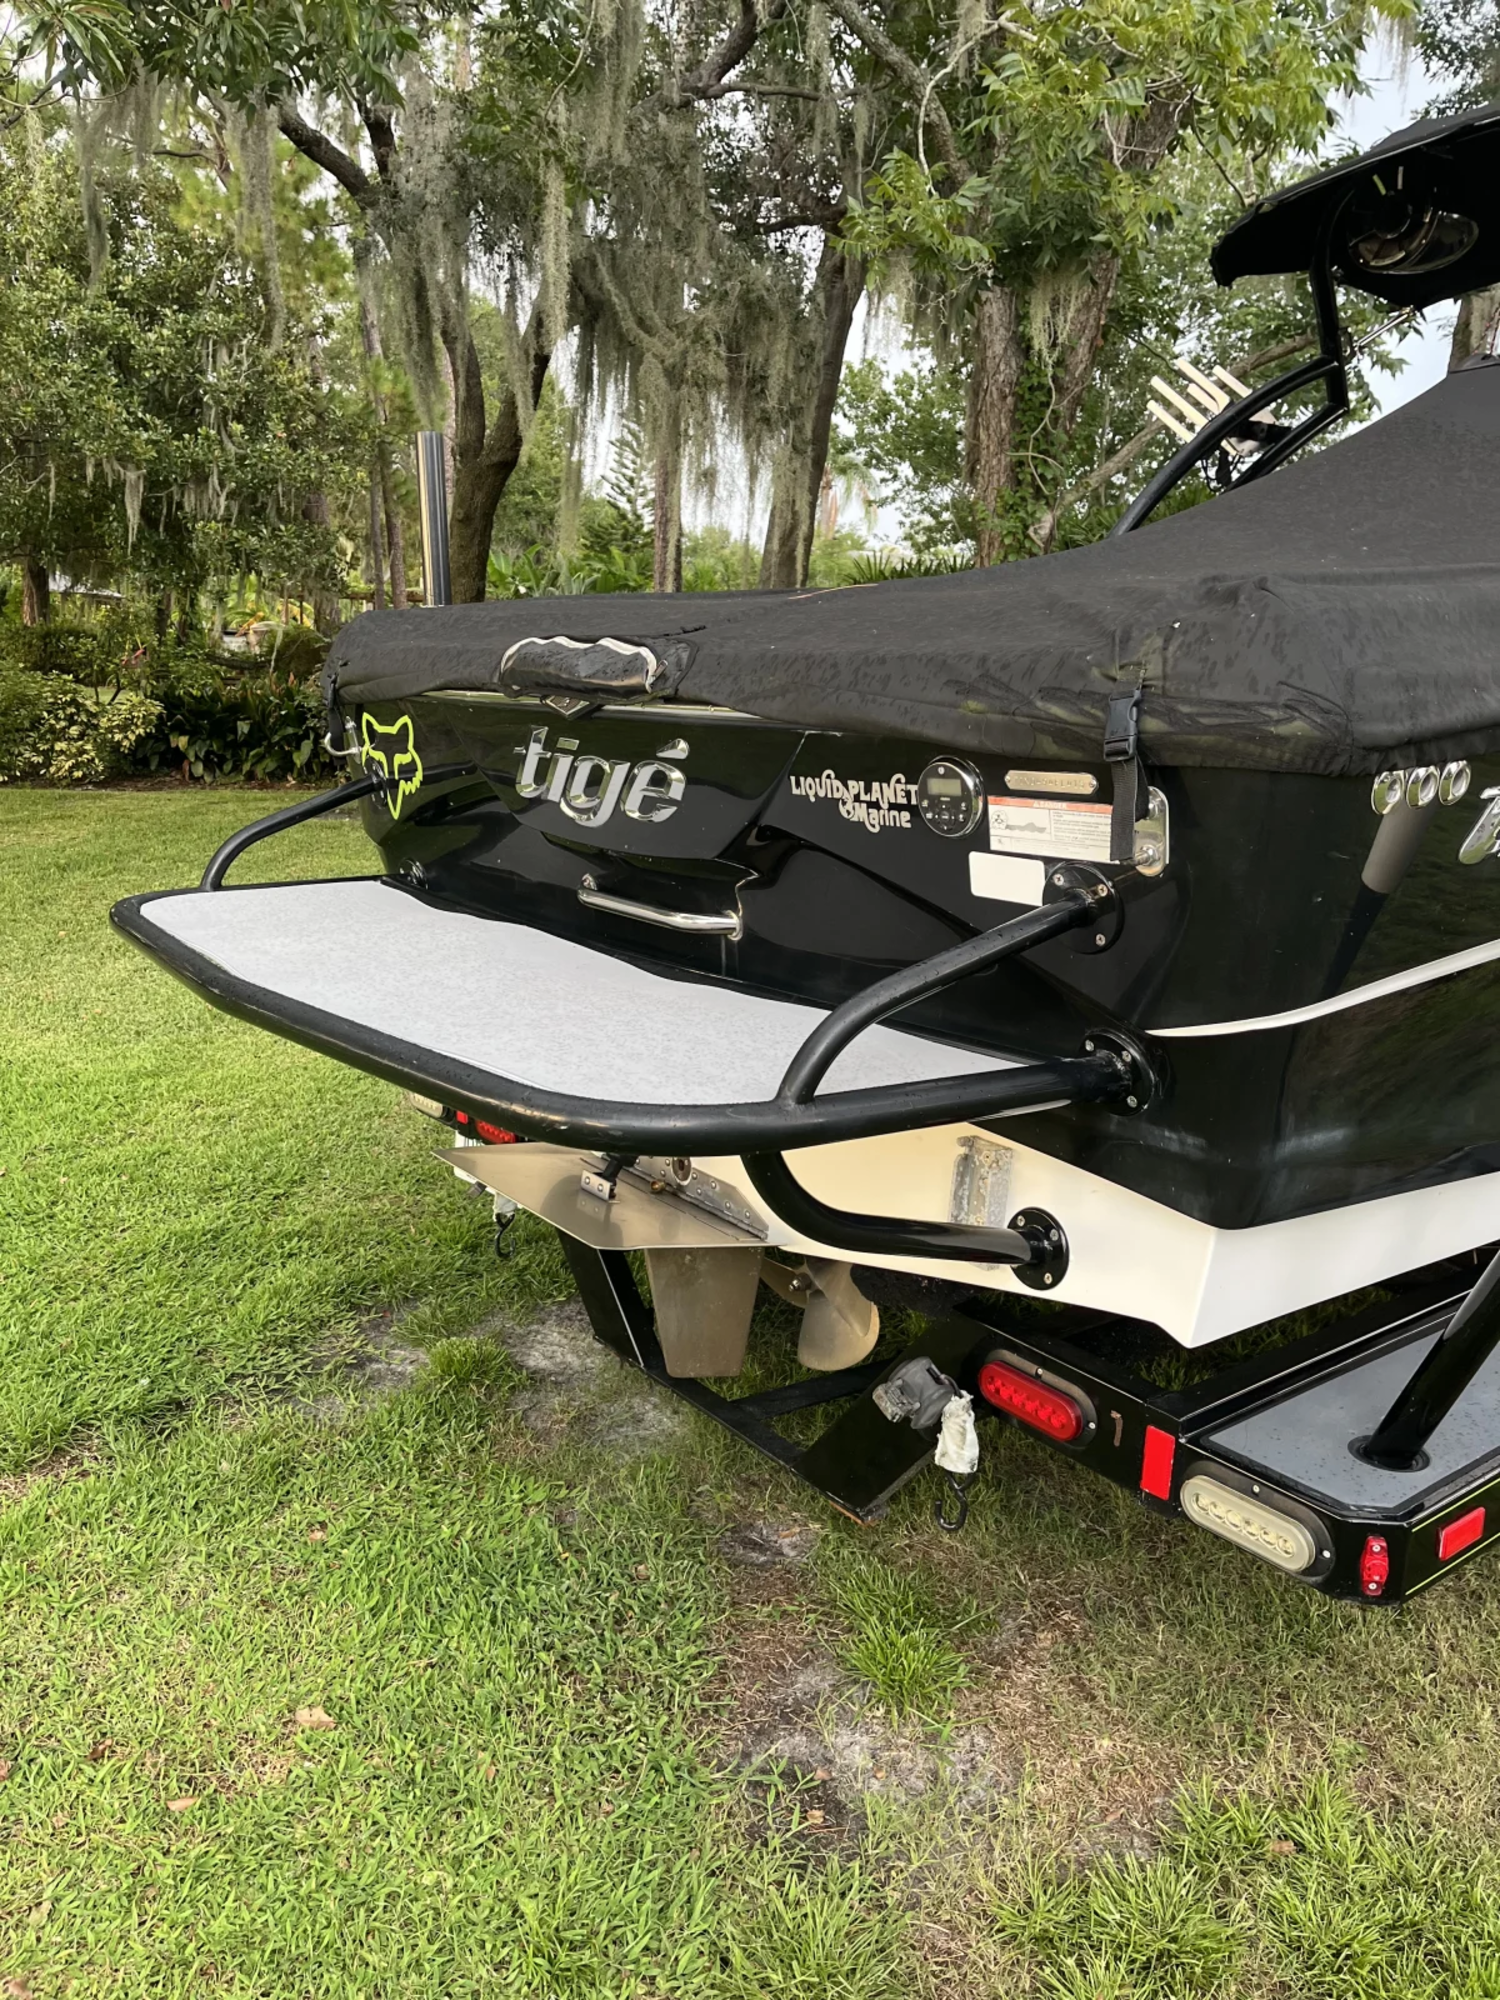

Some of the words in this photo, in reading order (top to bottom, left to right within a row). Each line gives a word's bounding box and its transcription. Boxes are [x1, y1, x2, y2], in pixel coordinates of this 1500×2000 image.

[513, 725, 691, 828] tigé
[789, 769, 845, 802] LIQUID
[847, 773, 918, 810] PLANET
[850, 802, 912, 833] Marine
